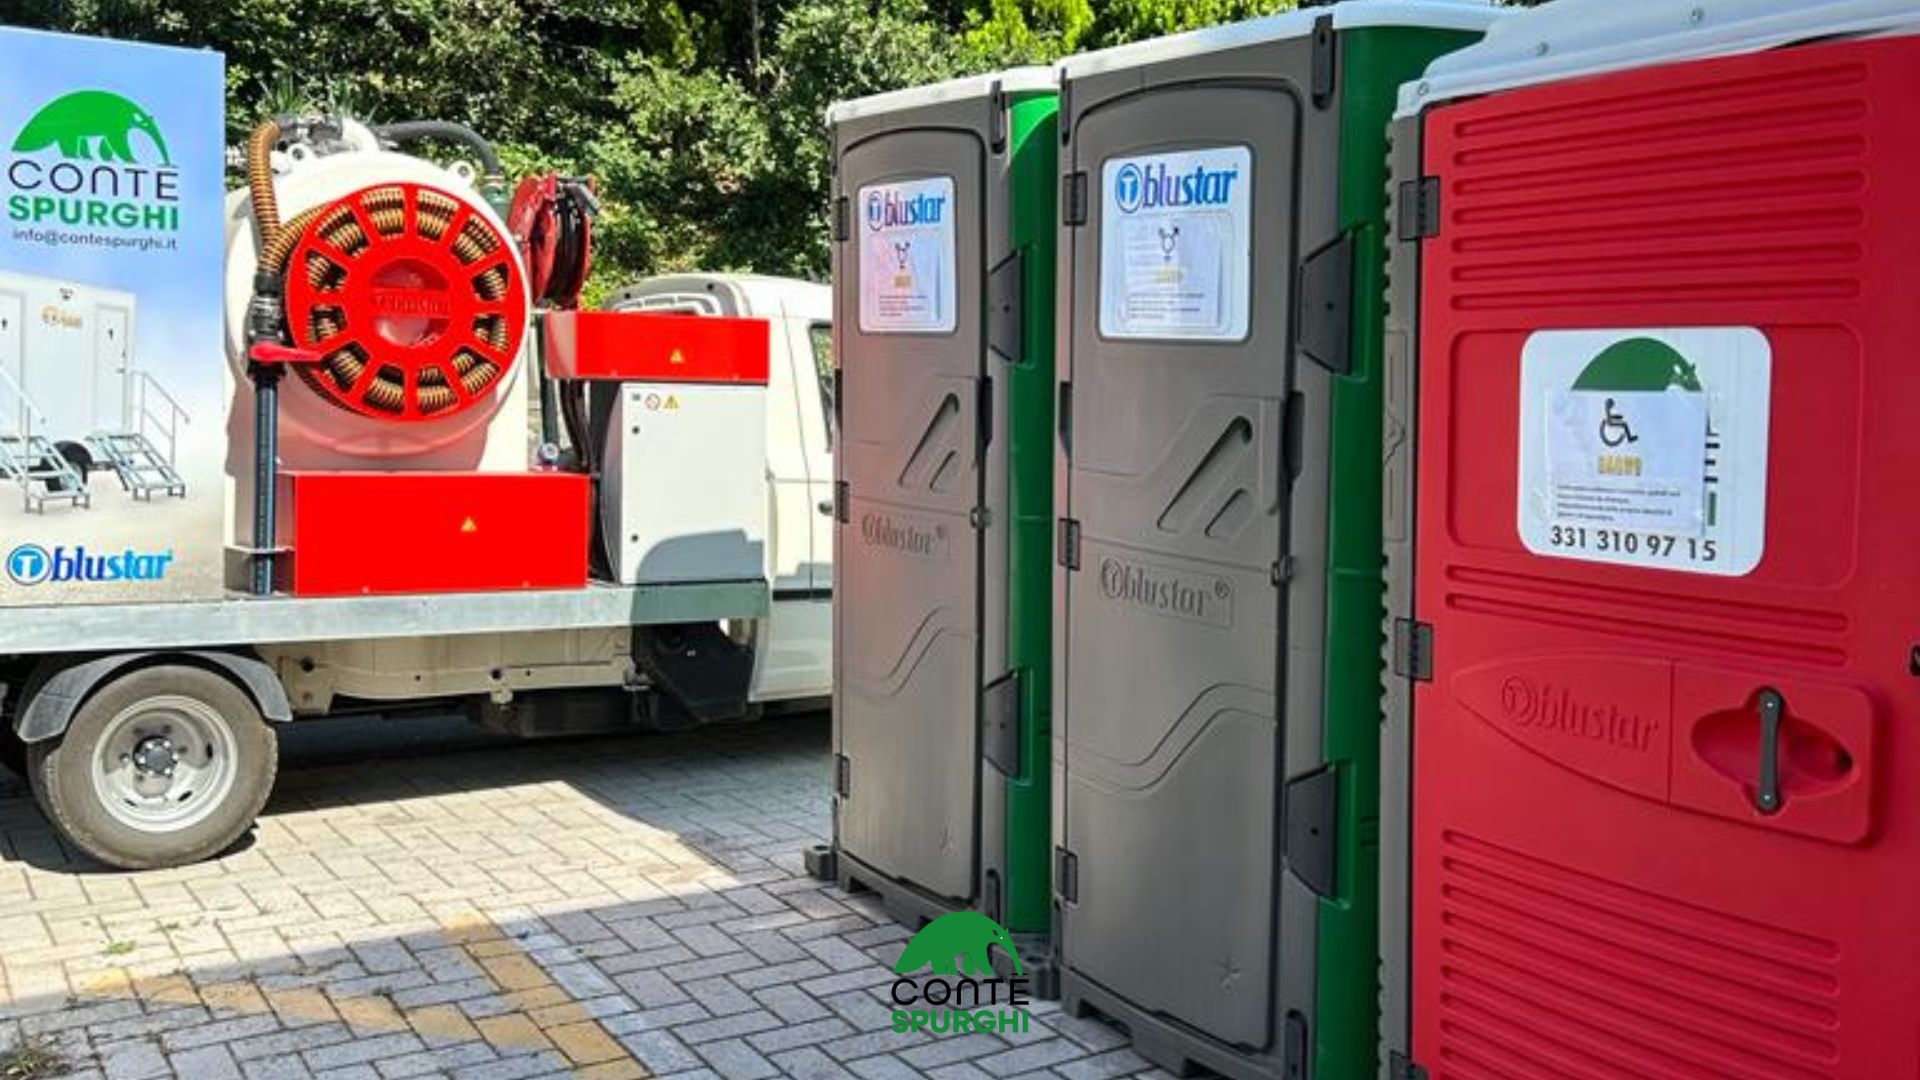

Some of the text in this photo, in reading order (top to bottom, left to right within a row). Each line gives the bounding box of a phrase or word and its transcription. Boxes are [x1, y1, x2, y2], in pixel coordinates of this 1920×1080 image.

[8, 160, 179, 200] CONTE
[1143, 163, 1238, 208] blustar
[9, 195, 179, 231] SPURGHI
[13, 228, 177, 250] info@contespurghi.it
[1550, 525, 1716, 561] 331 310 97 15
[51, 545, 173, 581] blustar
